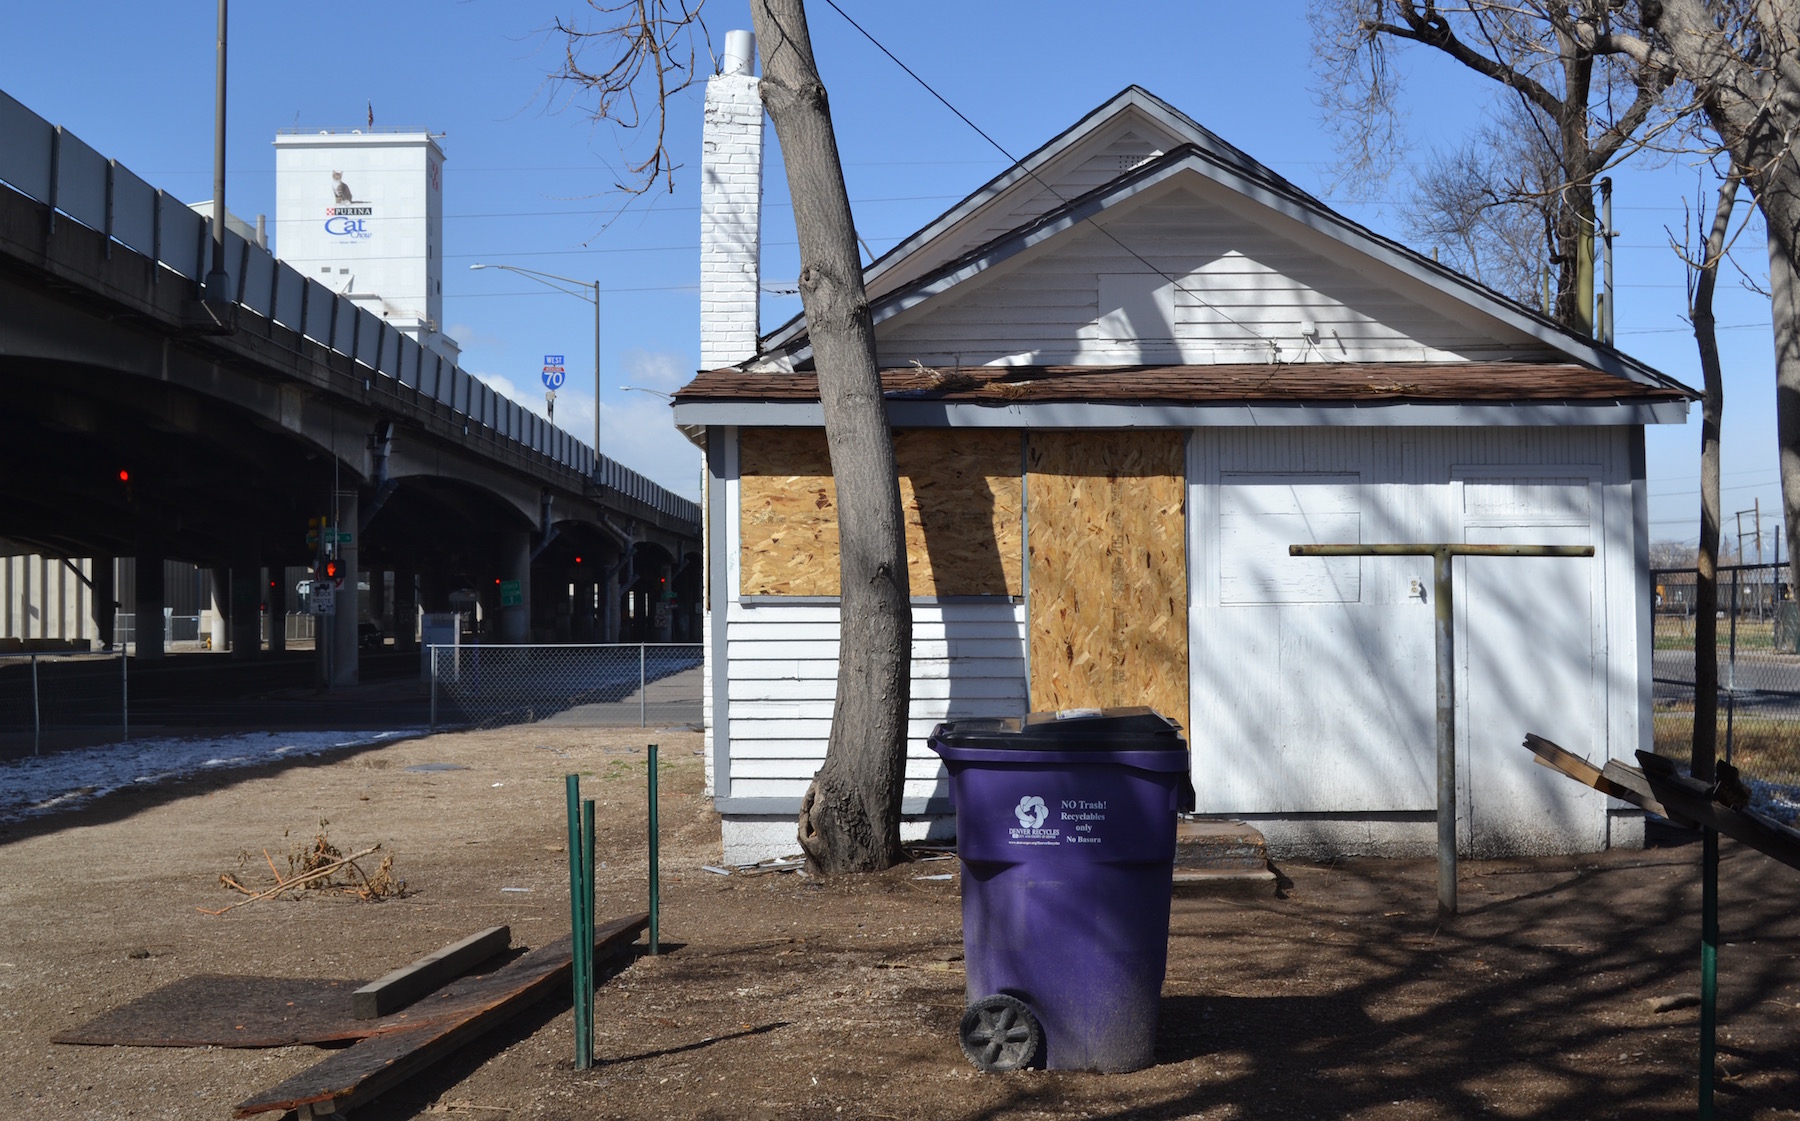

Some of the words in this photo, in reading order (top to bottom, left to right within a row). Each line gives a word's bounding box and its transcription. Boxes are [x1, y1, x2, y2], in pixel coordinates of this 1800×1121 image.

[325, 217, 367, 235] Cat
[544, 372, 562, 386] 70
[1061, 800, 1077, 809] NO
[1079, 800, 1107, 809] Trash!
[1061, 812, 1105, 821] Recyclables
[1075, 824, 1092, 833] only
